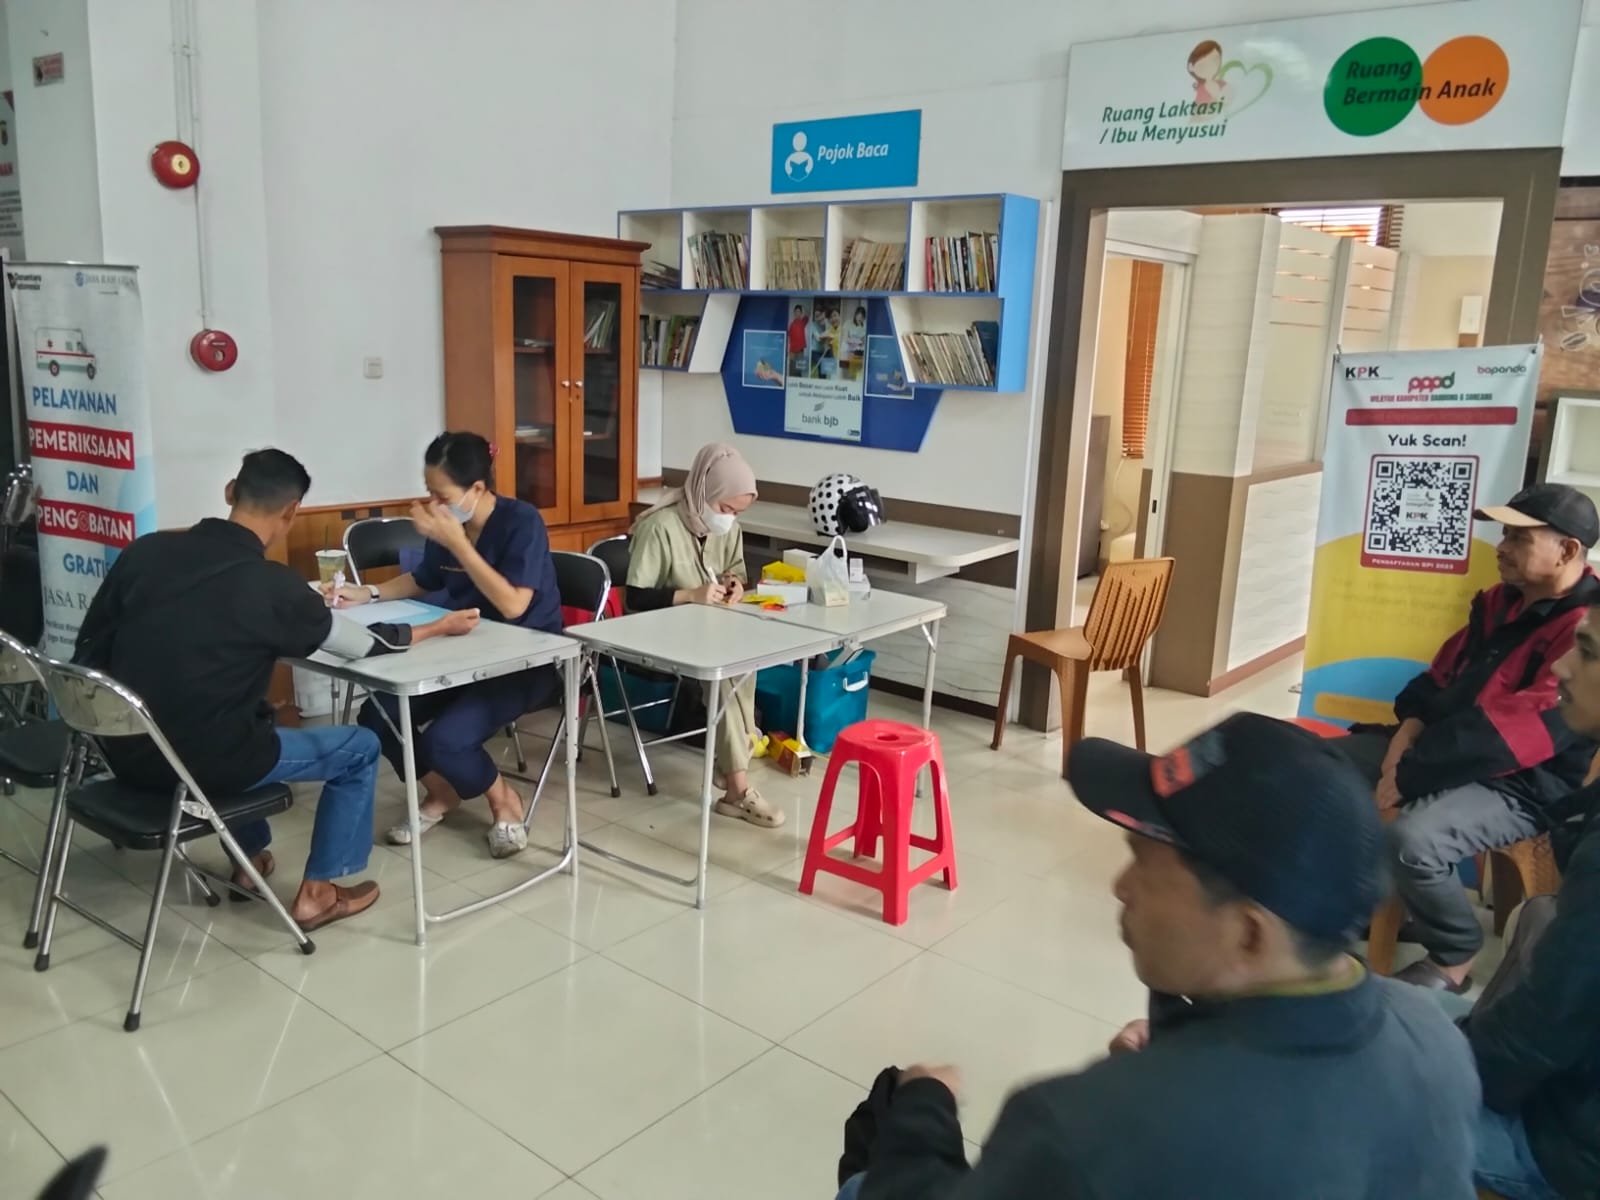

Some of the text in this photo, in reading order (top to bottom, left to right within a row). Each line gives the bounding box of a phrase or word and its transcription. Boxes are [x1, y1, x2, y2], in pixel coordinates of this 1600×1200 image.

[1345, 58, 1414, 82] Ruang
[1343, 76, 1496, 106] Bermain Anak
[1102, 96, 1225, 126] Ruang Laktasi
[1099, 119, 1228, 146] / Ibu Menyusui
[817, 141, 889, 165] Pojok Baca
[1345, 366, 1380, 379] KPK
[32, 386, 117, 416] PELAYANAN
[802, 413, 839, 428] bank bjb
[29, 426, 132, 462] PEMERIKSAAN
[1387, 433, 1467, 447] Yuk Scan!
[67, 470, 99, 494] DAN
[43, 585, 74, 608] JASA
